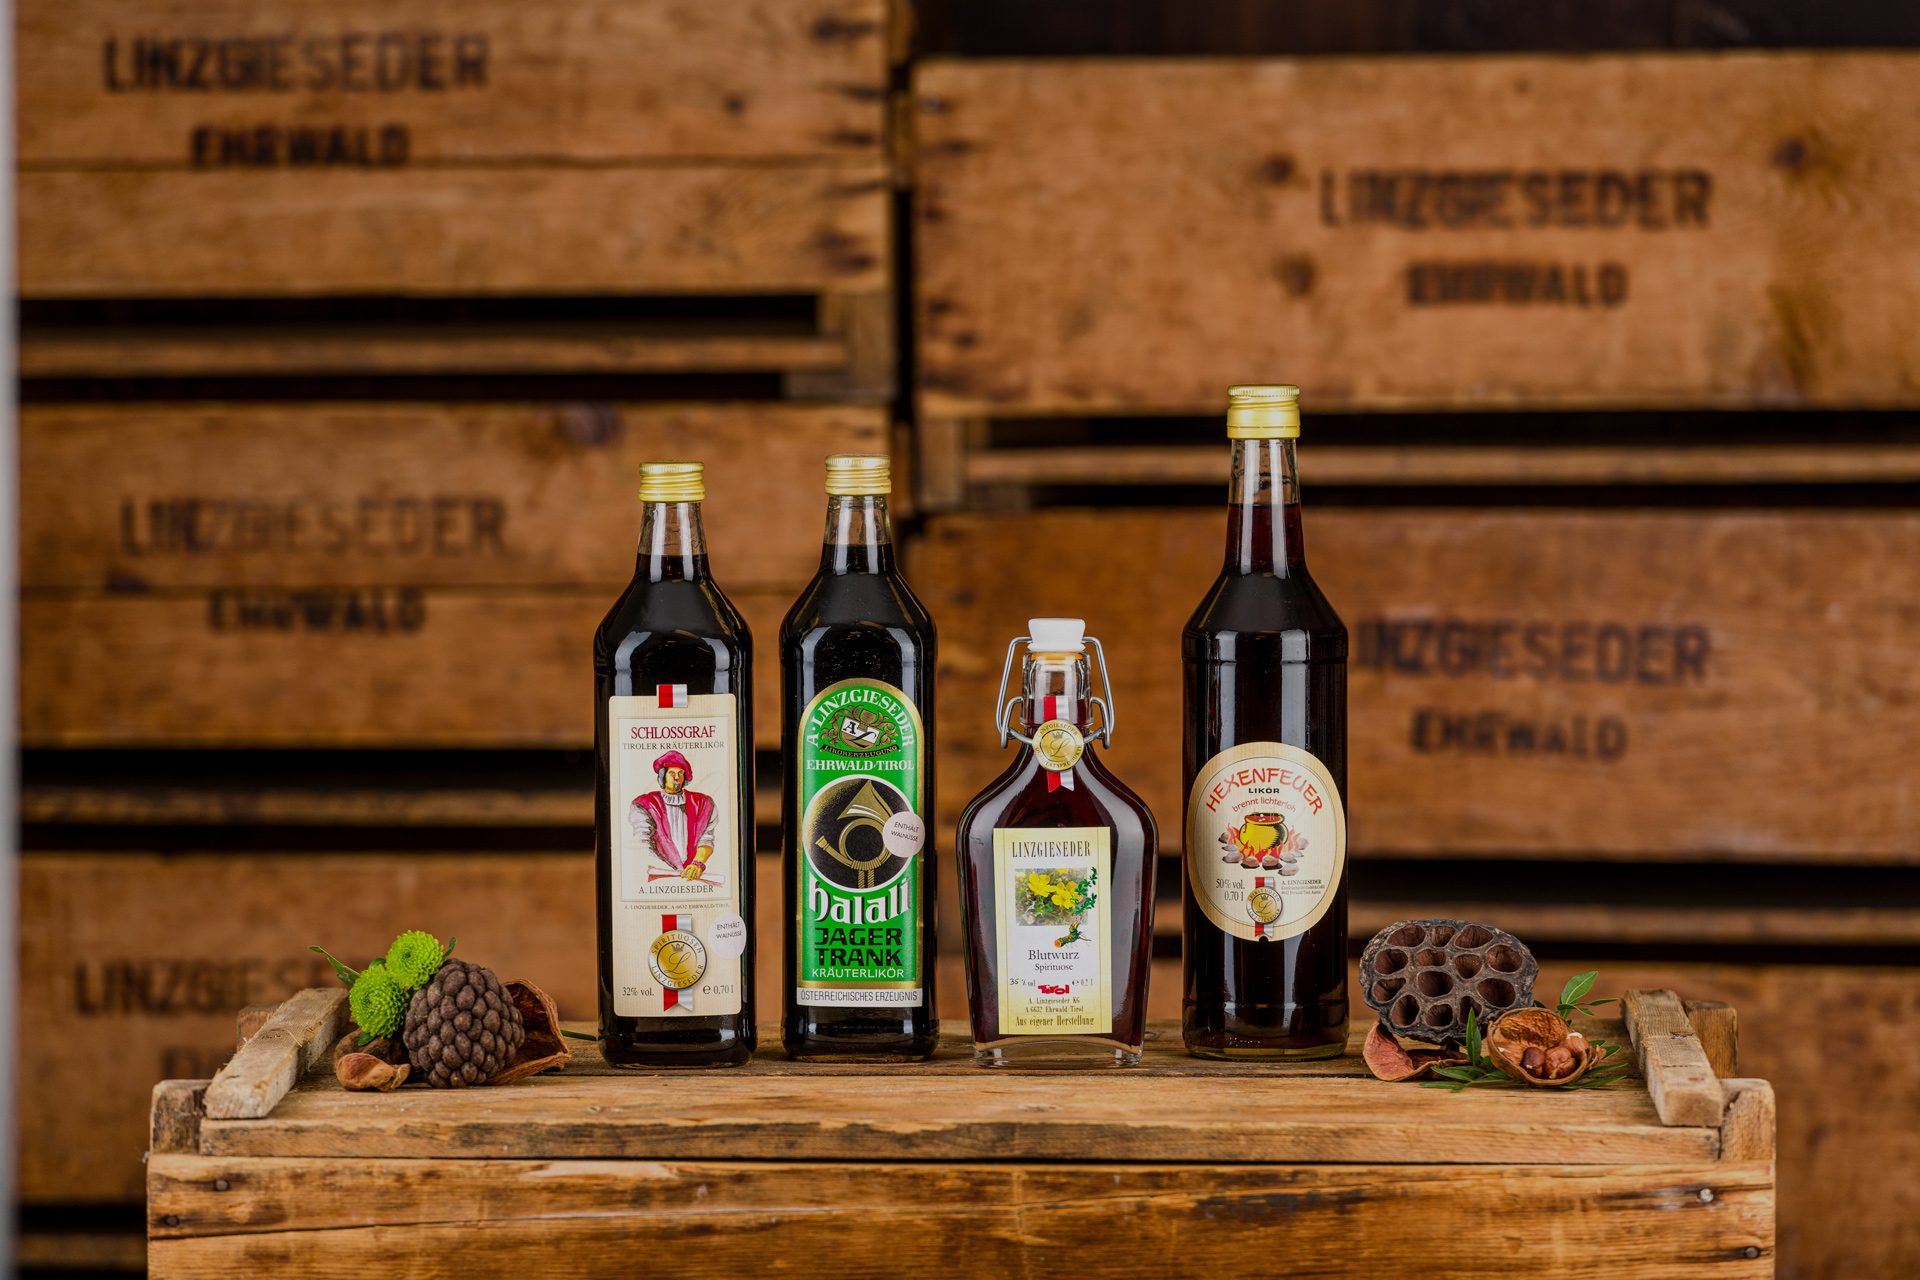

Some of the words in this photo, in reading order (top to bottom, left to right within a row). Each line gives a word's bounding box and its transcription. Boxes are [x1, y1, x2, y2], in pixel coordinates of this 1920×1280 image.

[631, 725, 716, 739] SCHLOSSGRAF
[622, 742, 658, 750] TIROLER
[660, 741, 725, 750] KRÄUTERLIKÖR
[1205, 767, 1323, 816] HEXENFEUER
[1231, 797, 1259, 812] brennt
[1260, 796, 1297, 813] lichterloh
[894, 821, 919, 832] ENTHÄLT
[1012, 840, 1091, 858] LINZGIESEDER
[639, 886, 648, 894] A.
[649, 885, 715, 895] LINZGIESEDER
[1232, 879, 1246, 890] vol.
[808, 871, 912, 925] halali
[716, 921, 740, 931] ENTHÄLT
[651, 933, 704, 955] SPIRITUOSEN
[814, 948, 903, 967] TRANK
[1028, 949, 1080, 960] Blutwurz
[812, 967, 905, 978] KRÄUTERLIKÖR
[1034, 963, 1074, 973] Spirituose
[651, 964, 704, 988] LINZGIESEDER
[621, 986, 638, 997] 32%
[640, 986, 655, 997] vol.
[800, 989, 874, 1002] ÖSTERREICHISCHES
[875, 990, 918, 1002] ERZEUGNIS
[1037, 984, 1070, 995] Tirol
[1015, 1016, 1027, 1026] Aus
[1029, 1016, 1054, 1028] eigener
[1056, 1015, 1095, 1027] Herstellung
